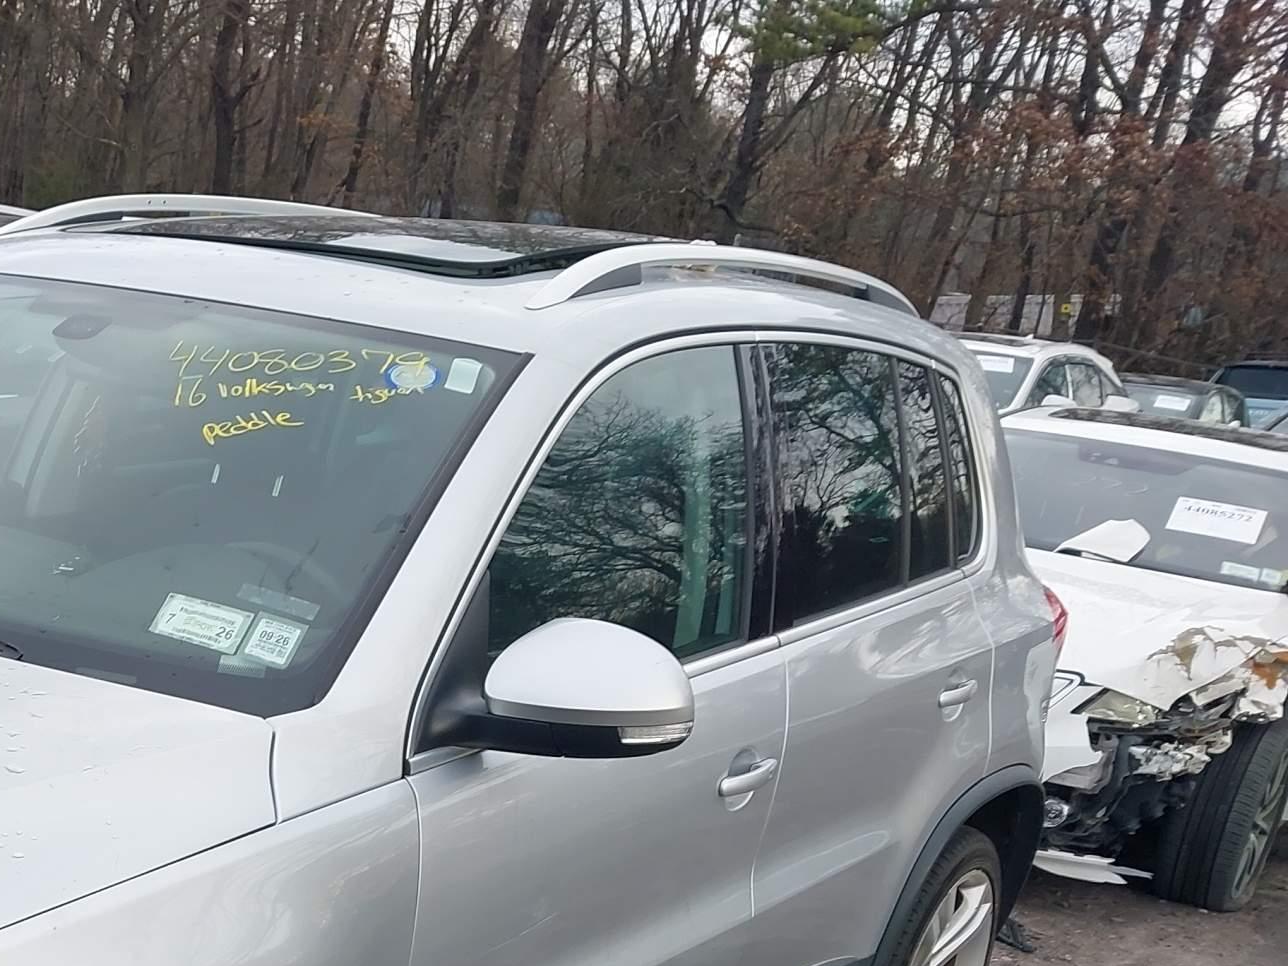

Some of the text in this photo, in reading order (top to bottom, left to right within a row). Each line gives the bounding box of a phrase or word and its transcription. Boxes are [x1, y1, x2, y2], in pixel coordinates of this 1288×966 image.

[169, 340, 431, 377] 44080379
[202, 410, 304, 445] peddle
[215, 626, 235, 641] 26
